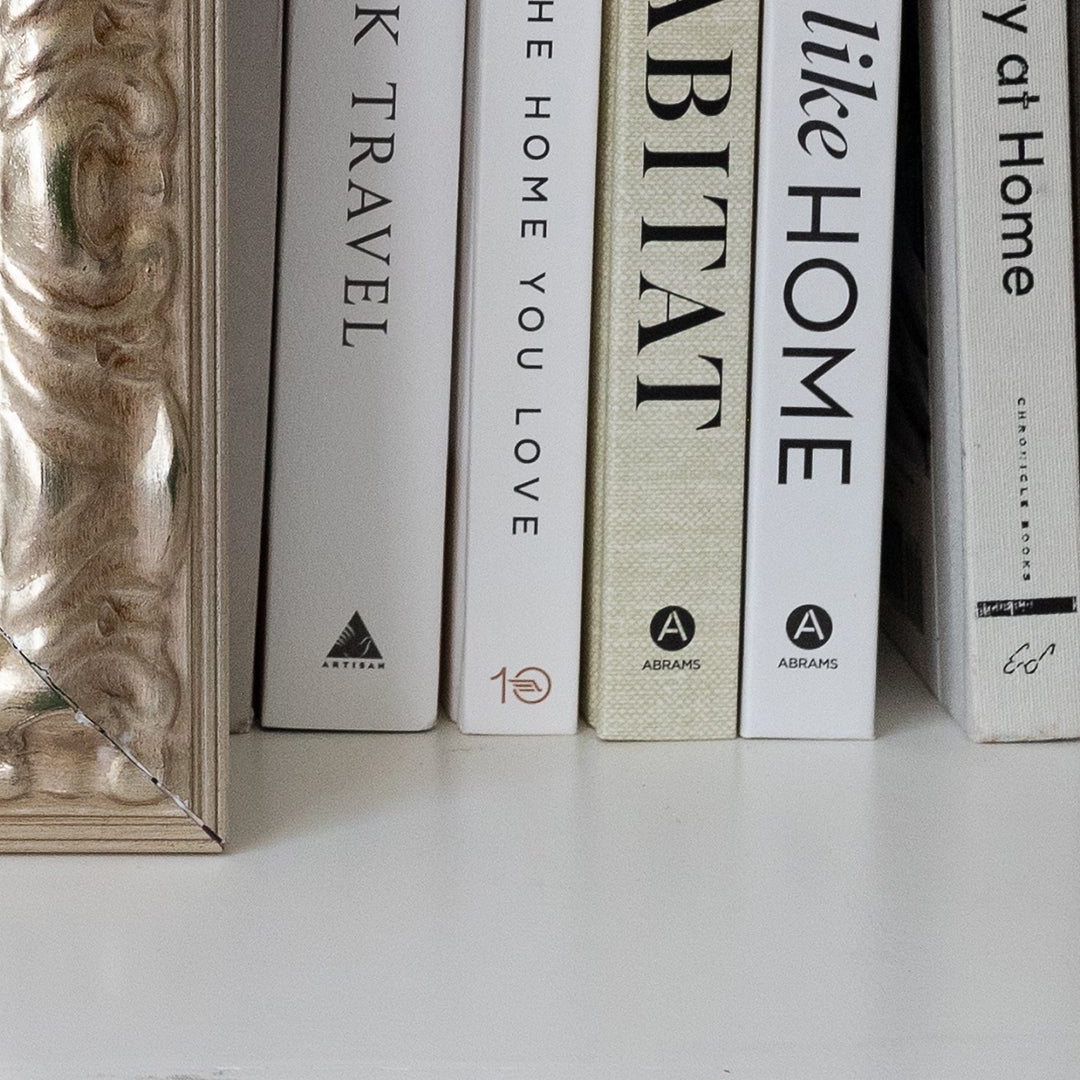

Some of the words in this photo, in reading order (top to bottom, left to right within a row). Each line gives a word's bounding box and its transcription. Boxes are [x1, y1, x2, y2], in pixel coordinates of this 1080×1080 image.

[797, 10, 880, 160] like
[996, 53, 1040, 110] at
[341, 82, 397, 348] TRAVEL
[520, 96, 552, 239] HOME
[998, 131, 1045, 297] Home
[516, 272, 546, 370] YOU
[777, 185, 861, 485] HOME
[512, 408, 542, 536] LOVE
[1021, 520, 1031, 581] BOOKS
[321, 661, 385, 670] ARTISAN
[641, 658, 702, 672] ABRAMS
[777, 657, 839, 670] ABRAMS
